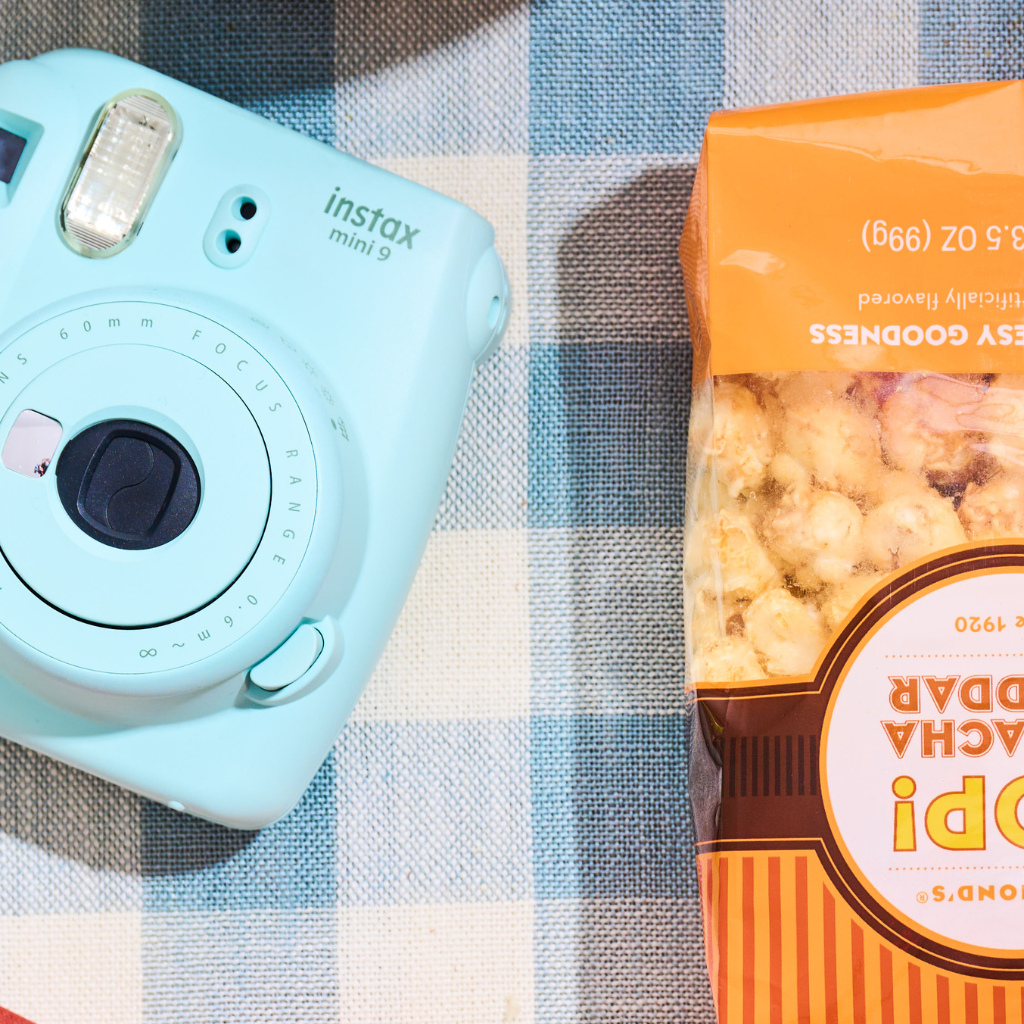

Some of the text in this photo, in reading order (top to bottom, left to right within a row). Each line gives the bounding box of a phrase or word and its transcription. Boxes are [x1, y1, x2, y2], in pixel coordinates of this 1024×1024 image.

[323, 186, 421, 250] instax
[328, 228, 391, 261] mini 9
[861, 219, 931, 253] (99g)
[941, 225, 977, 251] OZ
[858, 292, 939, 311] flavored
[809, 323, 968, 346] GOODNESS
[192, 329, 281, 412] FOCUS
[273, 449, 302, 564] RANGE
[955, 616, 1006, 633] 1920
